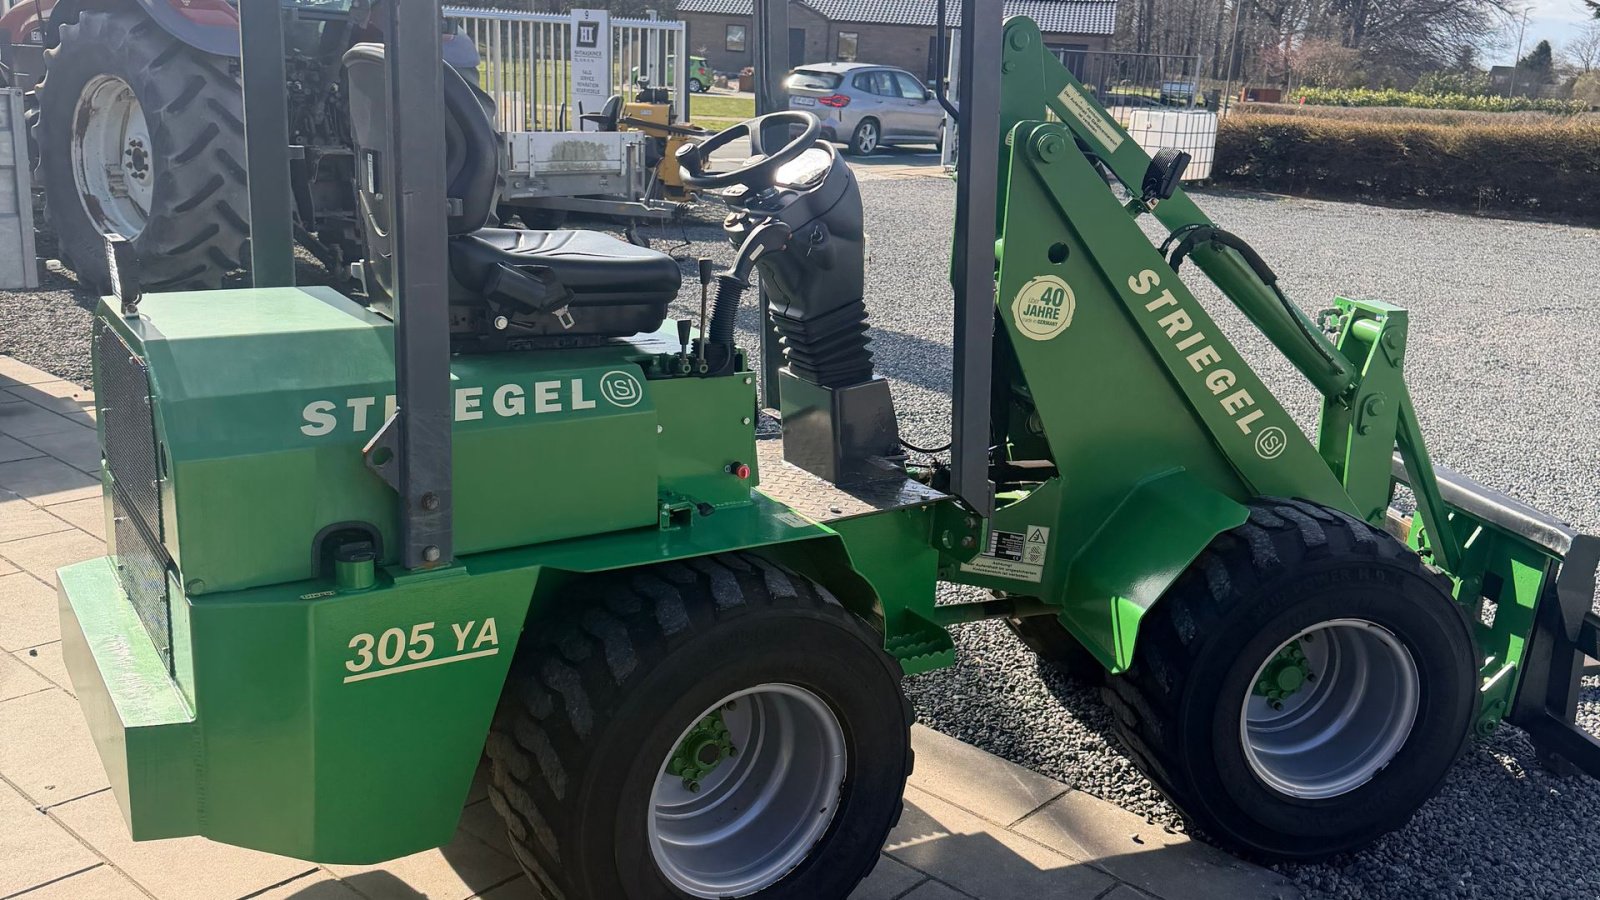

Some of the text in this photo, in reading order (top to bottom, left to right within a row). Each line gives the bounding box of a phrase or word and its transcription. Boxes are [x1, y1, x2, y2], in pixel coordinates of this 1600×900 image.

[1023, 304, 1060, 320] JAHRE
[1040, 286, 1065, 307] 40
[1128, 269, 1265, 436] STRIEGEL
[300, 378, 596, 437] STEGEL
[345, 617, 499, 673] 305 YA
